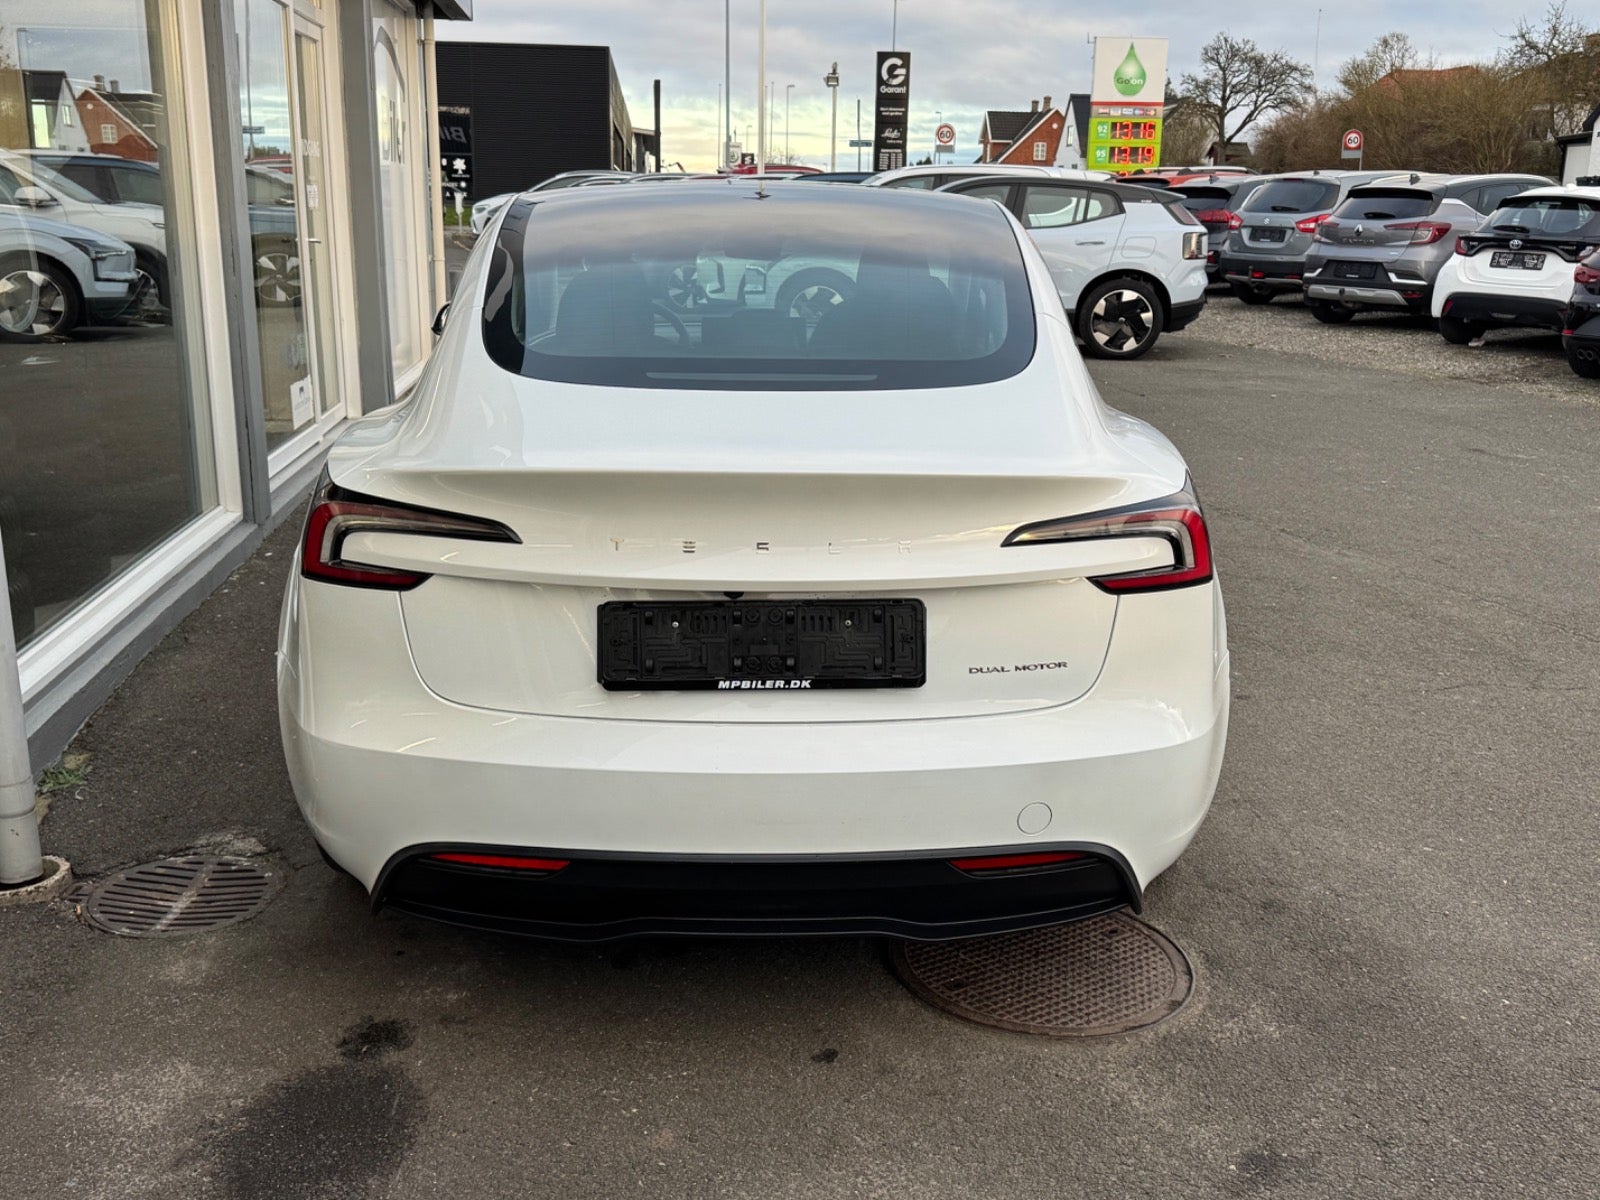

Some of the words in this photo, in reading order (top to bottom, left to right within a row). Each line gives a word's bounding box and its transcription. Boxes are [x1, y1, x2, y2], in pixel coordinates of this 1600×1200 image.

[880, 85, 907, 94] Garant
[940, 130, 951, 139] 60
[1097, 124, 1108, 133] 92
[1115, 121, 1155, 140] 13.16
[1347, 136, 1359, 144] 60
[1095, 150, 1106, 159] 95
[1114, 146, 1154, 165] 13.19
[610, 537, 912, 554] TESLA
[968, 666, 1010, 674] DUAL
[1014, 661, 1068, 672] MOTOR
[717, 679, 812, 689] MPBILER.DK
